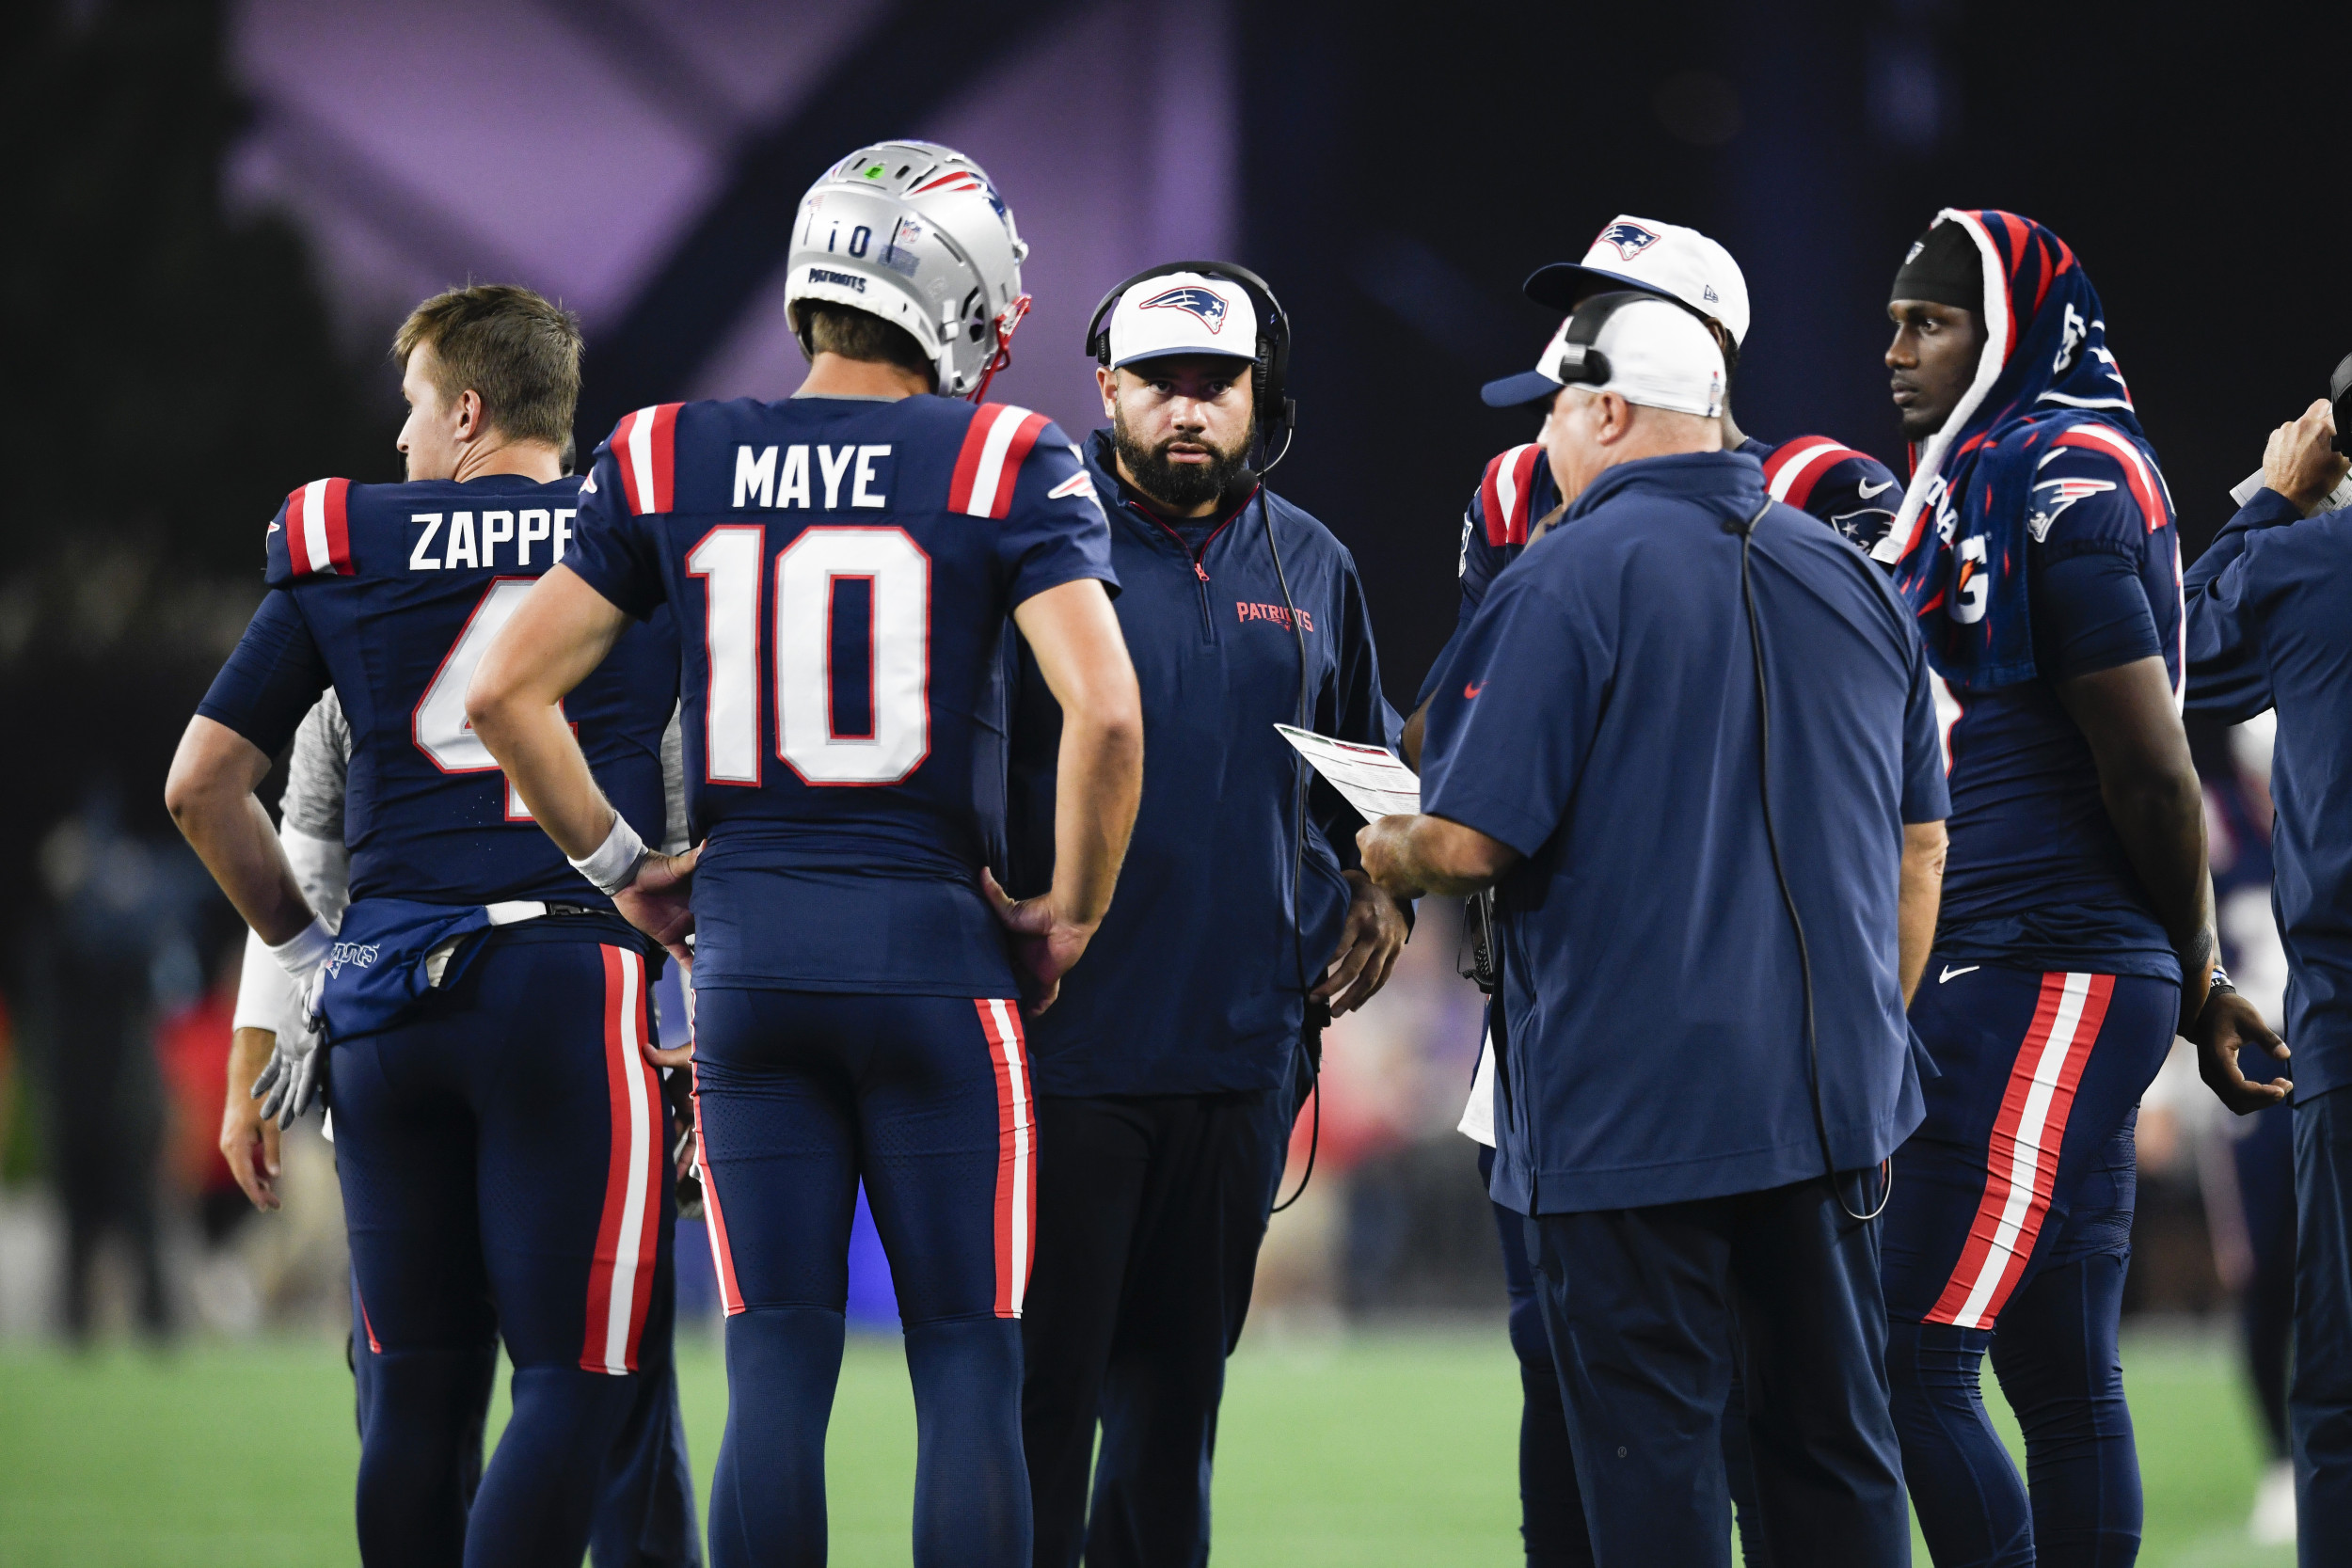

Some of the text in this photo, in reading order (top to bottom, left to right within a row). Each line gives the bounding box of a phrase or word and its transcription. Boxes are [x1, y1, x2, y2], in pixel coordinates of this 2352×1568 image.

[808, 267, 867, 293] PATRIOTS
[732, 444, 892, 509] MAYE
[685, 524, 931, 788] 10
